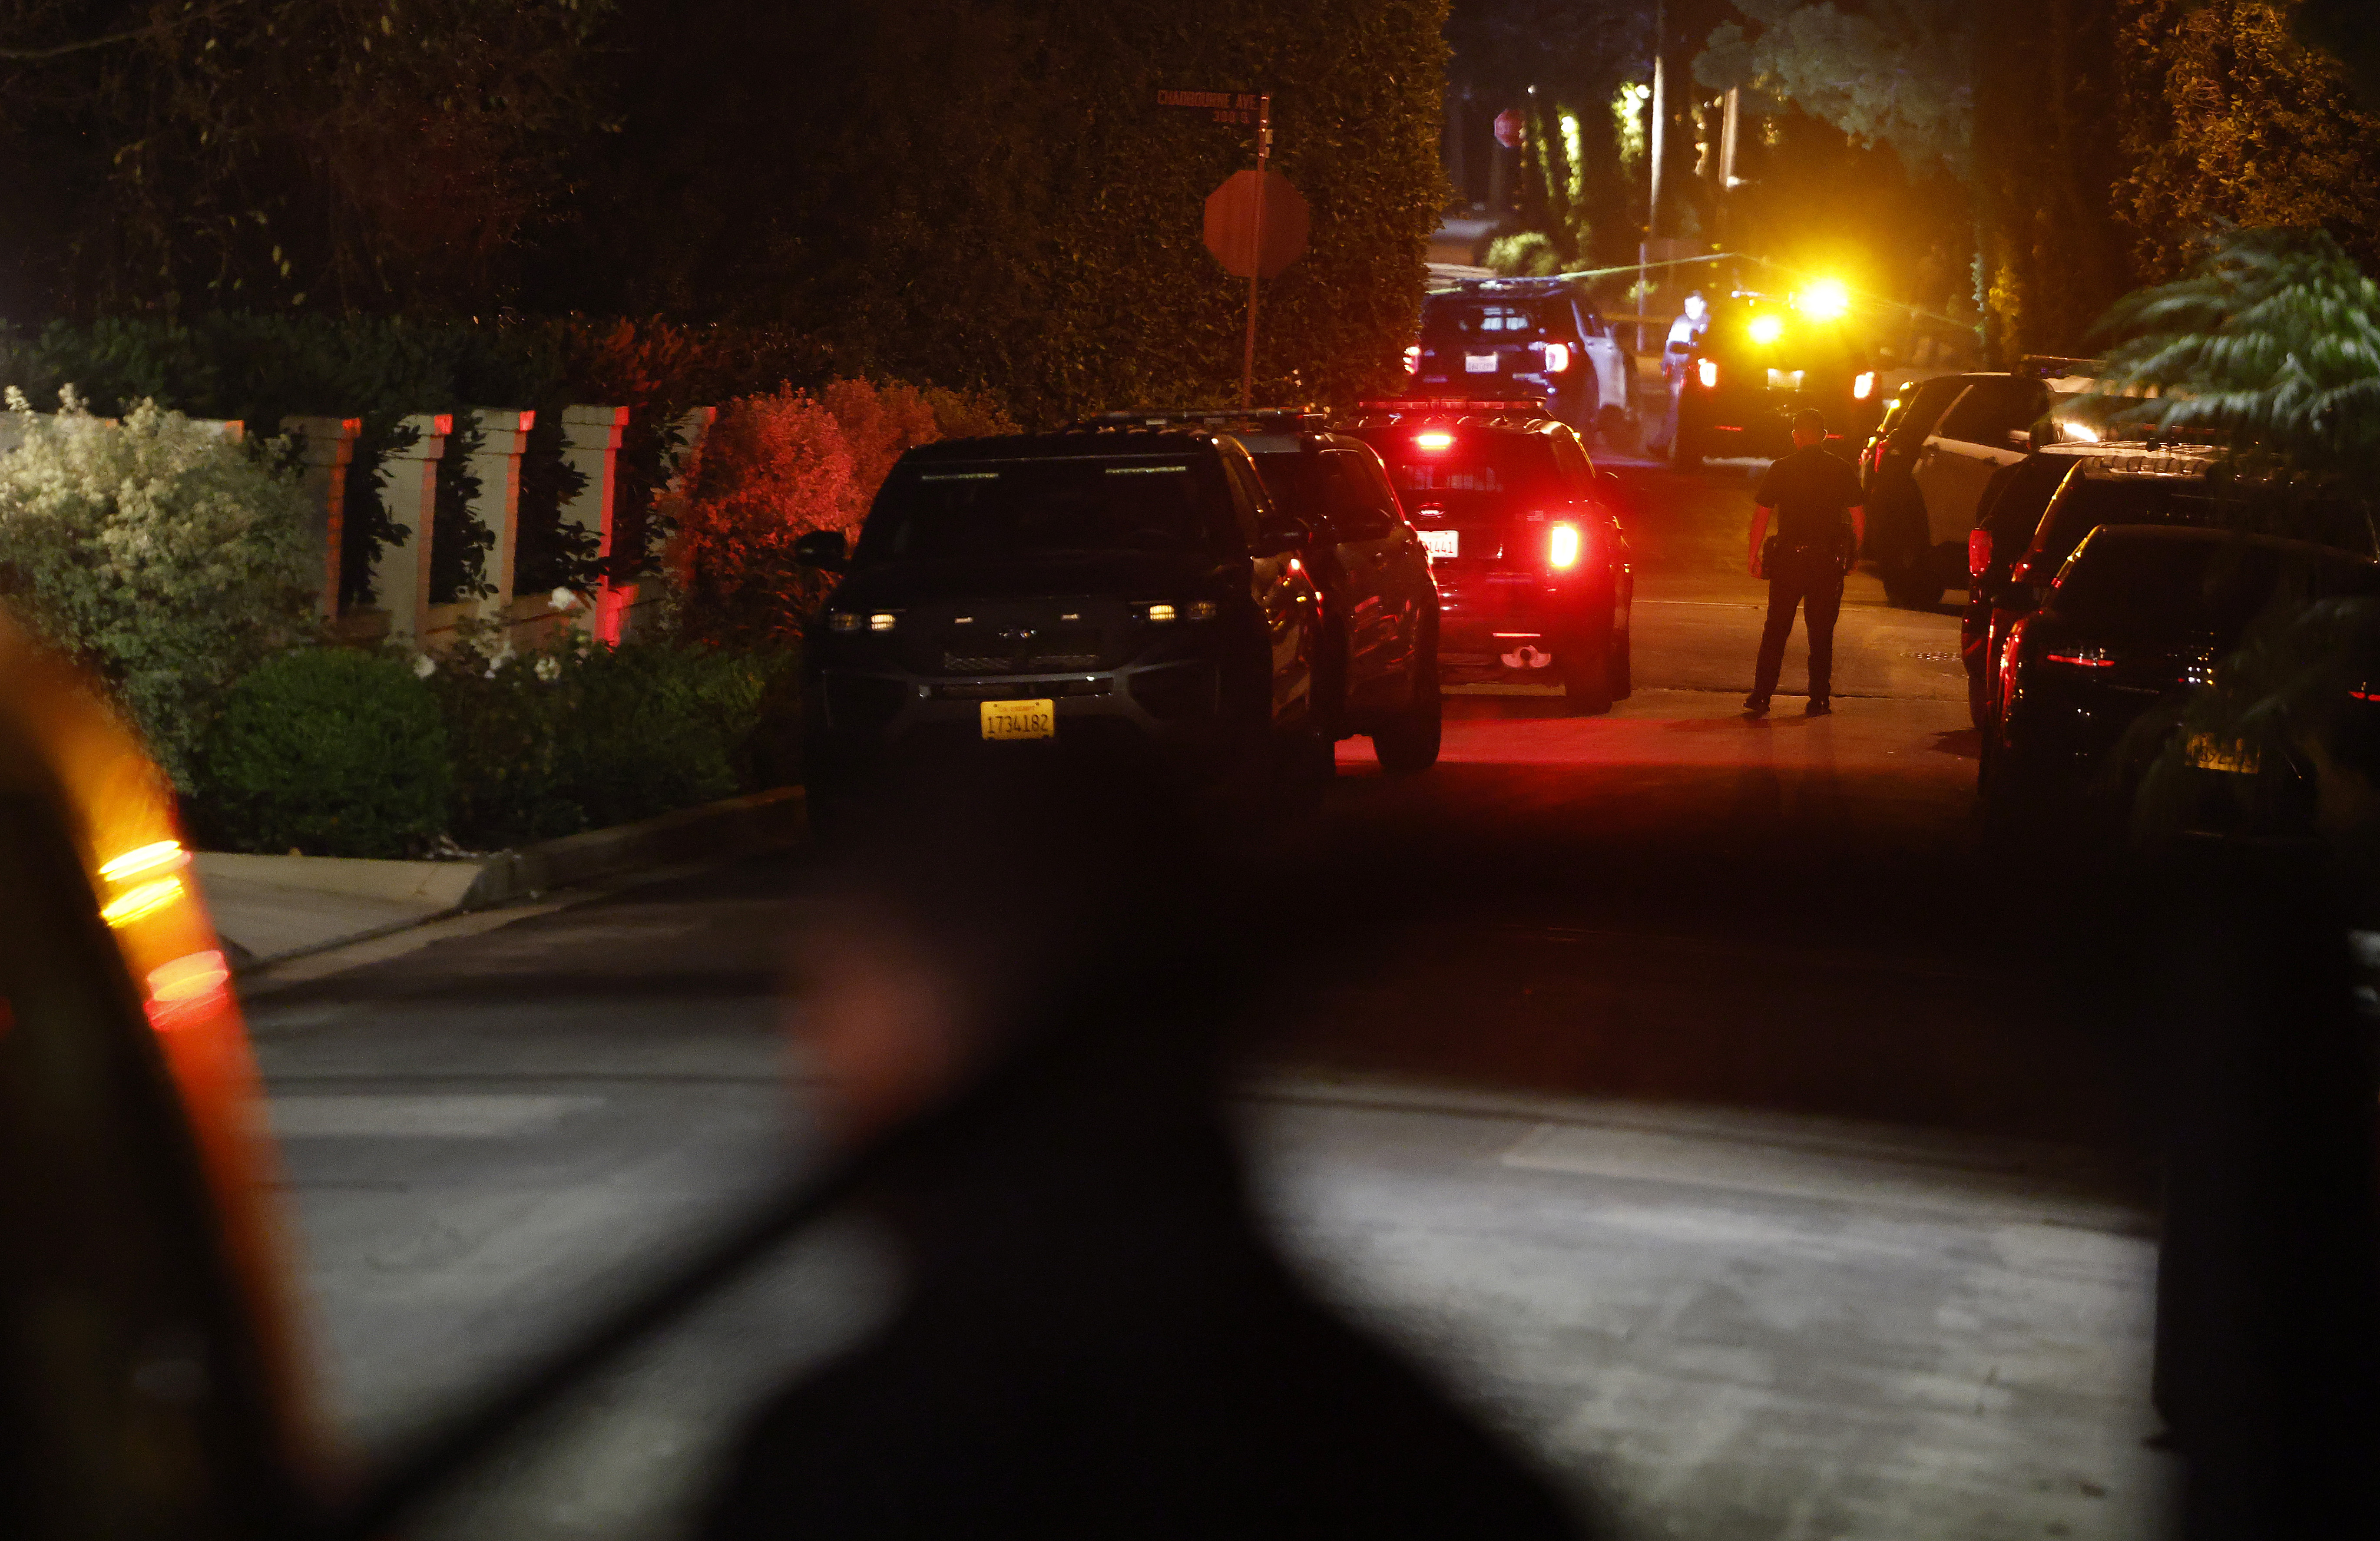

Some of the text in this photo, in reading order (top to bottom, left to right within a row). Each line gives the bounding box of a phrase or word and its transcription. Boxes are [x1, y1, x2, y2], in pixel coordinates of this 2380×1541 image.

[1157, 89, 1258, 110] CHADBOURNE AVE
[1422, 541, 1454, 553] 1441
[987, 714, 1048, 734] 1734182
